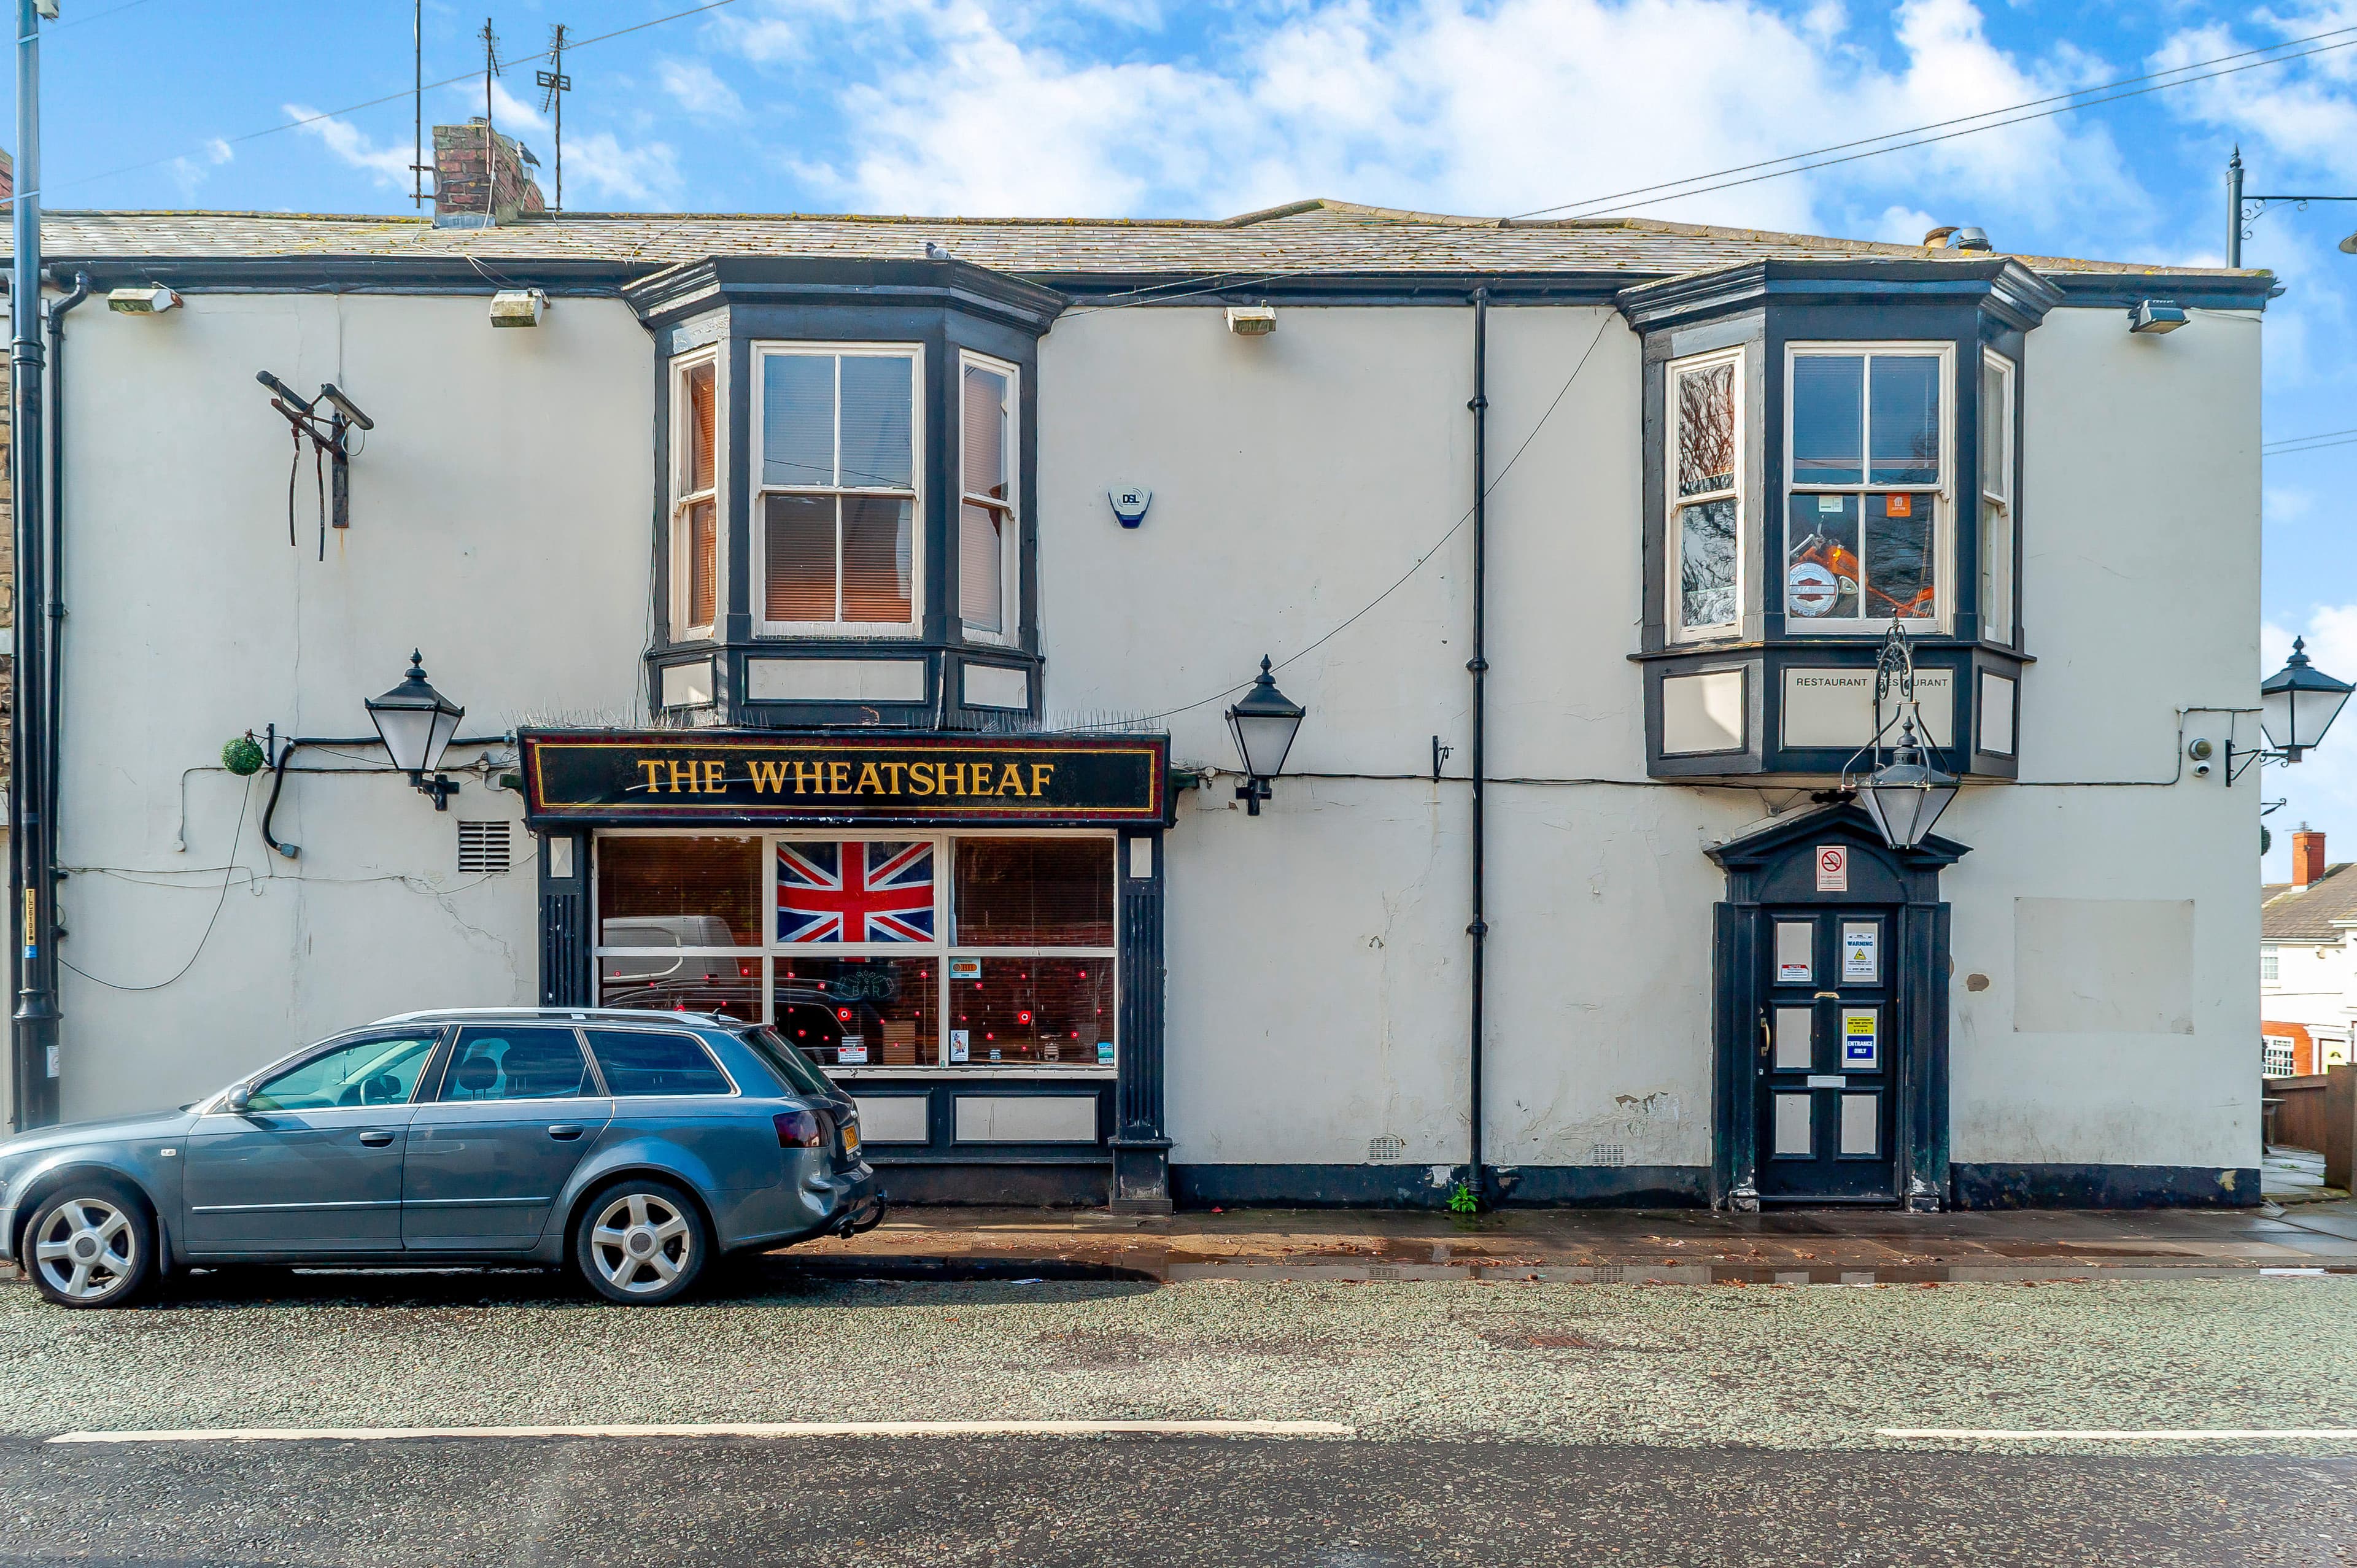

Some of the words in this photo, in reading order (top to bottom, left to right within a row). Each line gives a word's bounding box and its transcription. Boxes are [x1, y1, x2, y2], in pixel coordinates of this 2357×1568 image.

[1123, 494, 1140, 503] DSL
[637, 760, 727, 794] THE
[746, 761, 1054, 796] WHEATSHEAF
[853, 986, 880, 997] BAR
